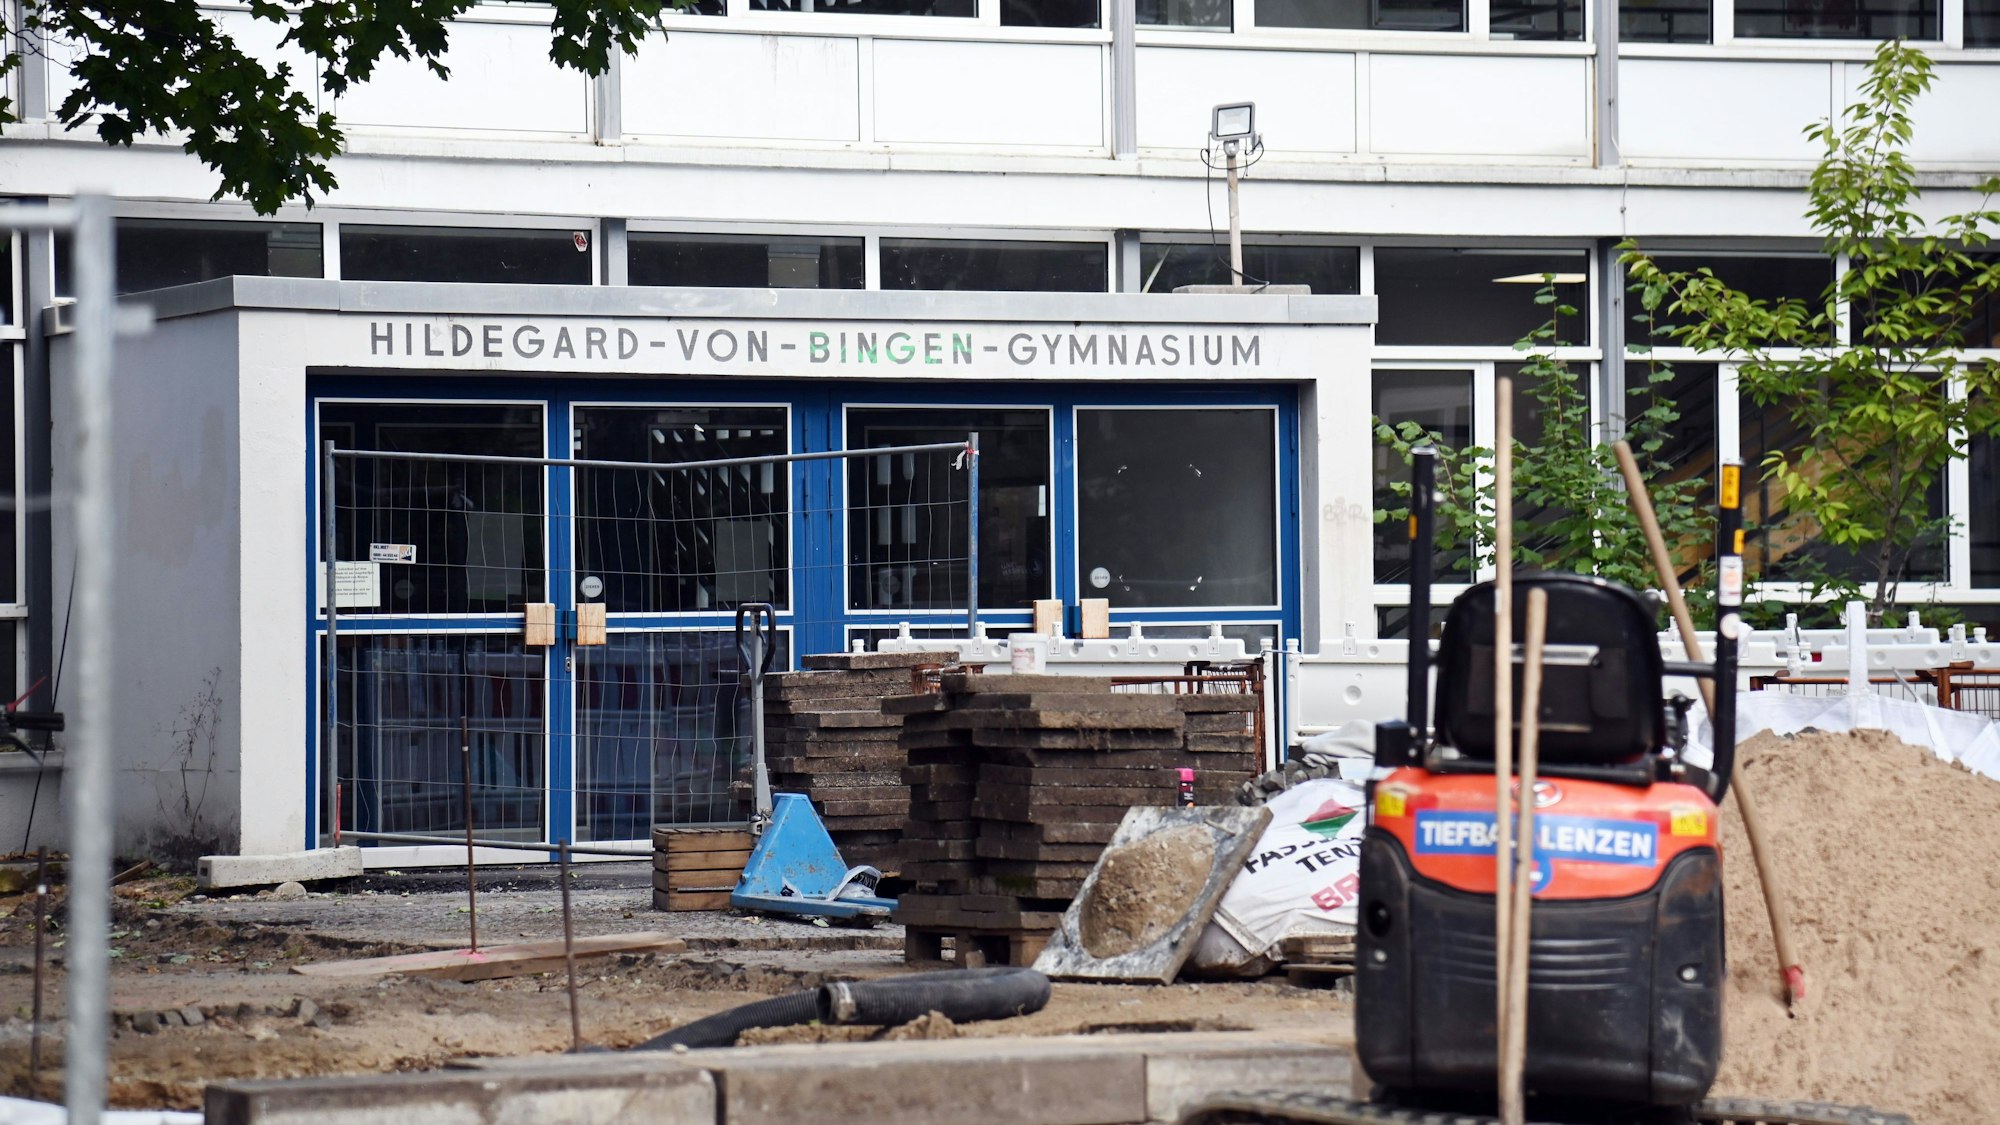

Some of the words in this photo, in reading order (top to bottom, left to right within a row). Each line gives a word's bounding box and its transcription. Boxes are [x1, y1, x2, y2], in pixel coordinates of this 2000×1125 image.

[371, 322, 1261, 366] HILDEGARD-VON-BINGEN-GYMNASIUM
[1420, 821, 1517, 848] TIEFBA
[1541, 825, 1652, 859] LENZEN
[1311, 870, 1361, 912] BR
